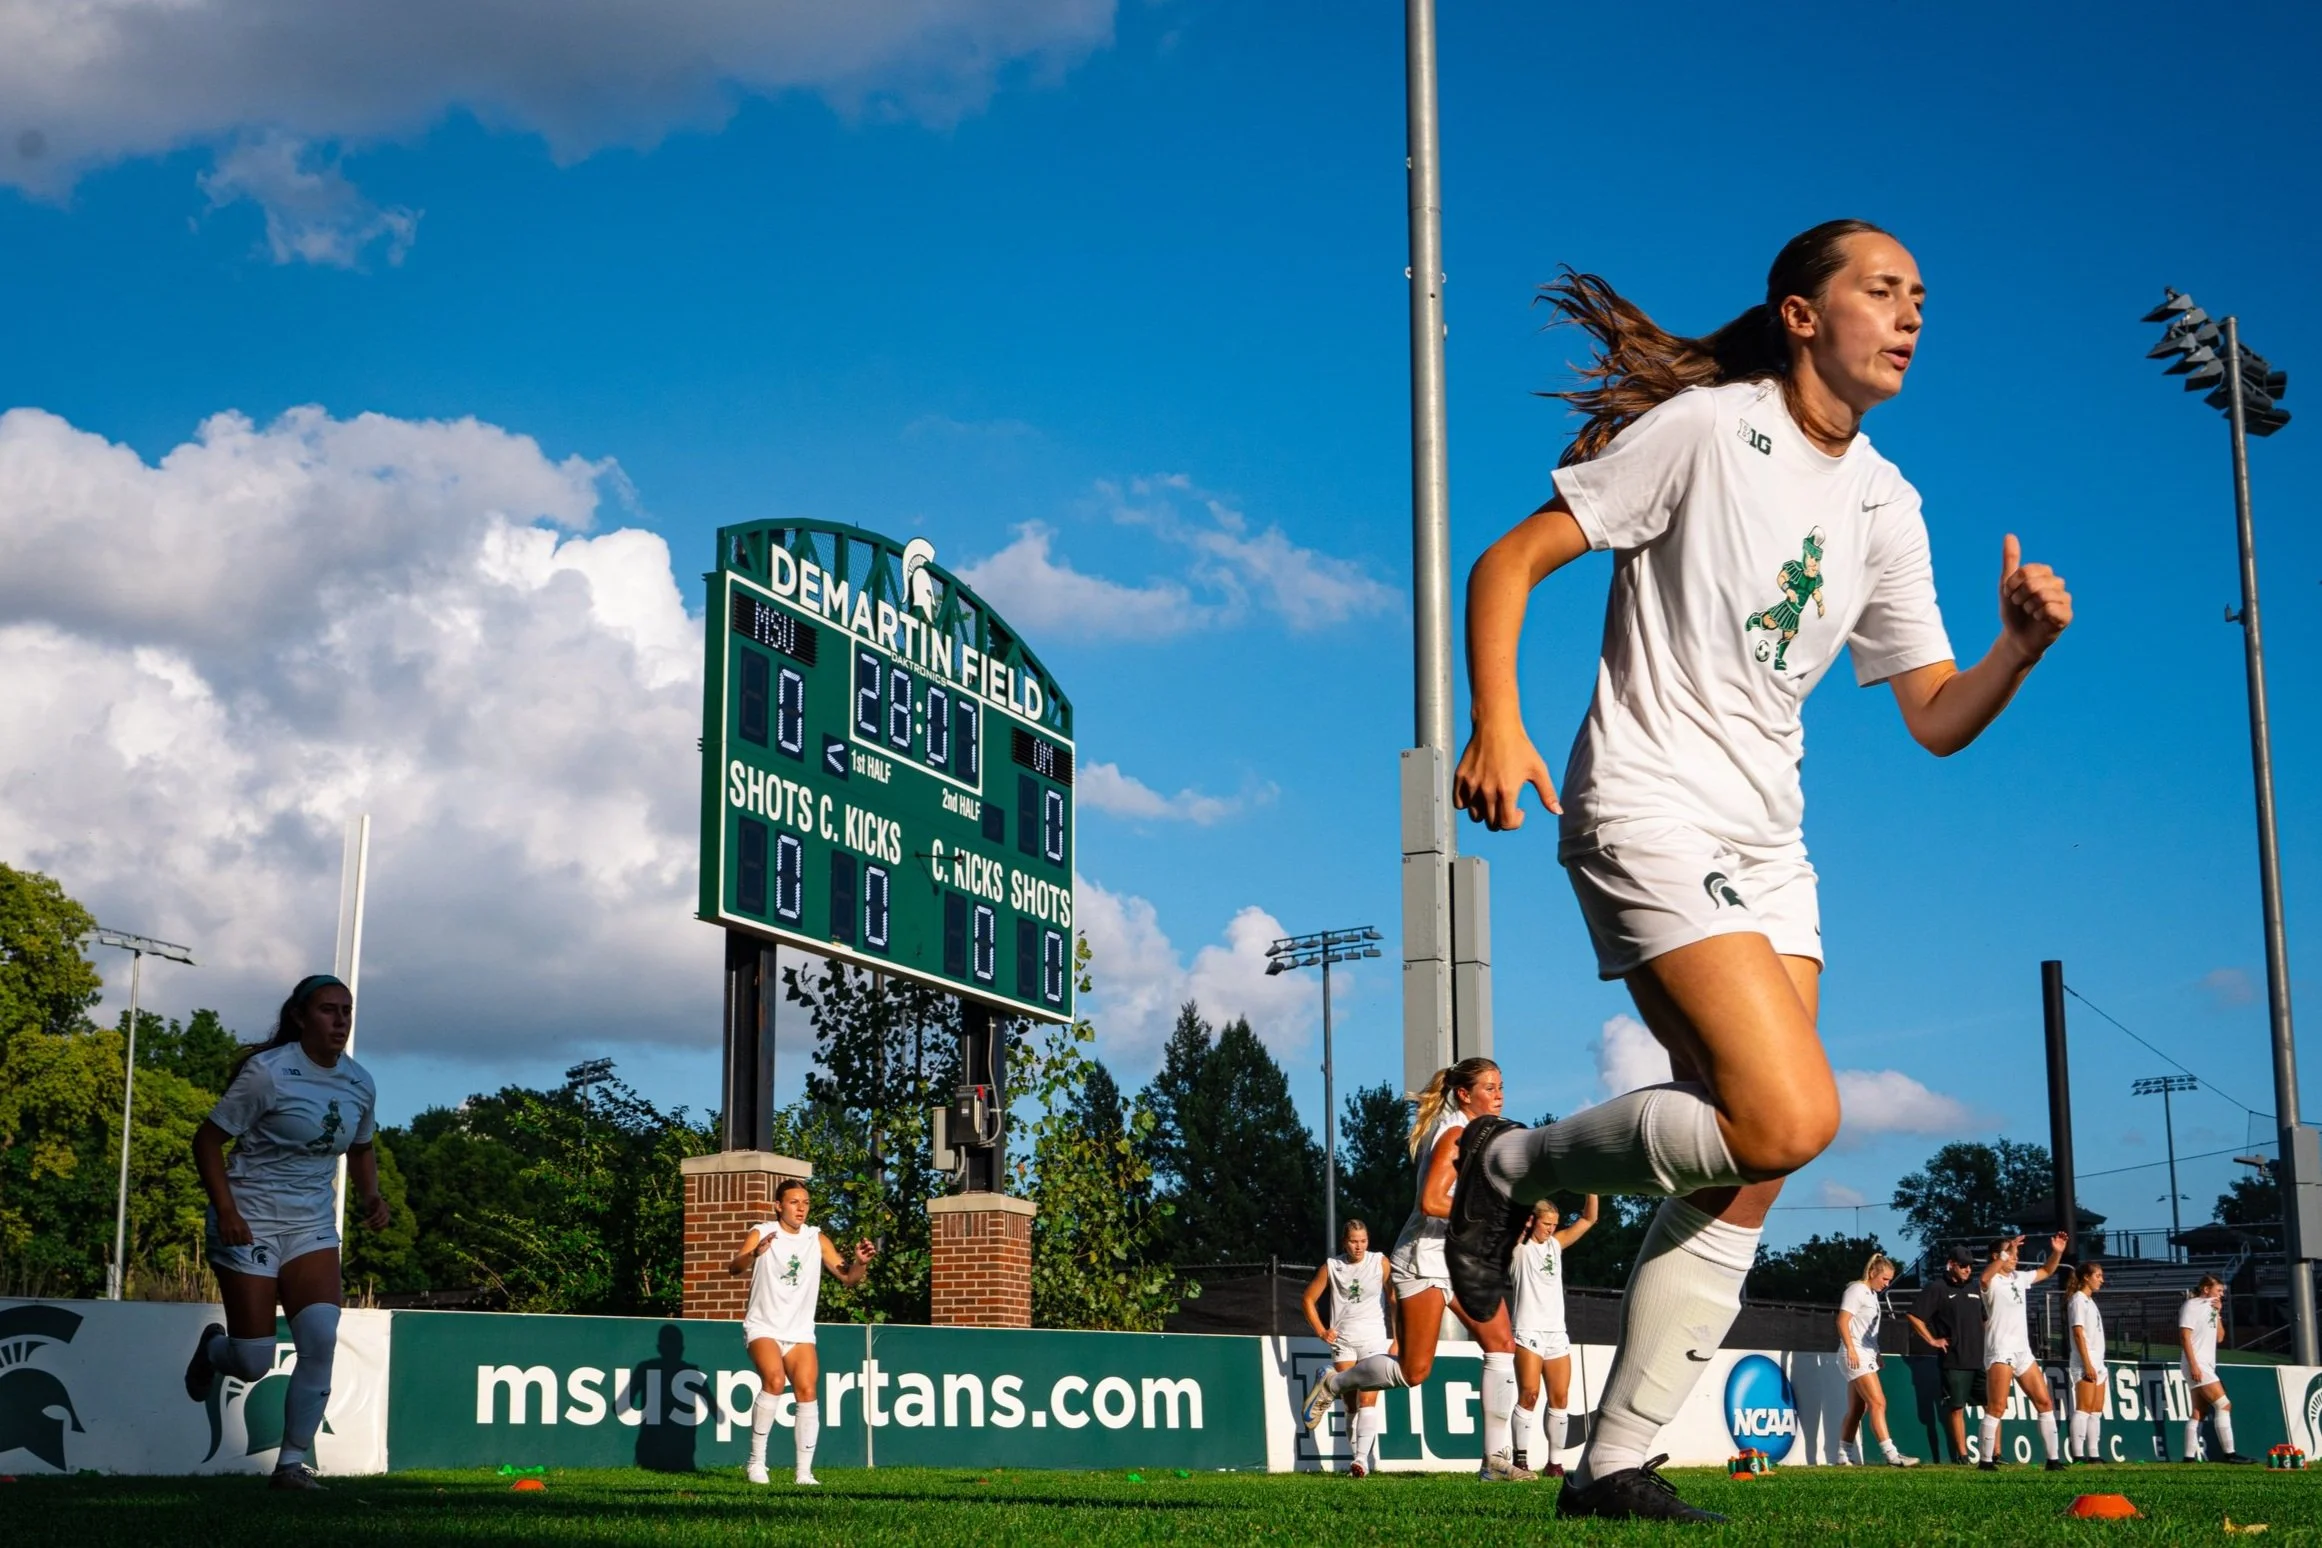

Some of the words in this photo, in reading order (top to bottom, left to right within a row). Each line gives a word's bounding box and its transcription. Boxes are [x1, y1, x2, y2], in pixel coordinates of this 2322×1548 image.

[754, 601, 794, 654] MSU
[771, 543, 952, 679] DEMARTIN
[962, 644, 1044, 720] FIELD
[891, 651, 947, 687] DAKTRONICS
[778, 668, 803, 754] 0
[857, 653, 977, 774] 28:07
[851, 749, 865, 774] 1st
[867, 755, 892, 785] HALF
[942, 788, 958, 813] 2nd
[959, 794, 981, 822] HALF
[729, 759, 813, 833] SHOTS
[819, 794, 838, 842] C.
[845, 803, 902, 866] KICKS
[1045, 788, 1064, 863] 0
[776, 833, 802, 920] 0
[865, 865, 889, 947] 0
[932, 838, 949, 884] C.
[954, 846, 1004, 903] KICKS
[1011, 869, 1071, 928] SHOTS
[974, 904, 995, 981] 0
[1045, 930, 1063, 1003] 0
[476, 1358, 1204, 1442] msuspartans.com
[1733, 1407, 1796, 1437] NCAA
[2116, 1366, 2200, 1422] STAT
